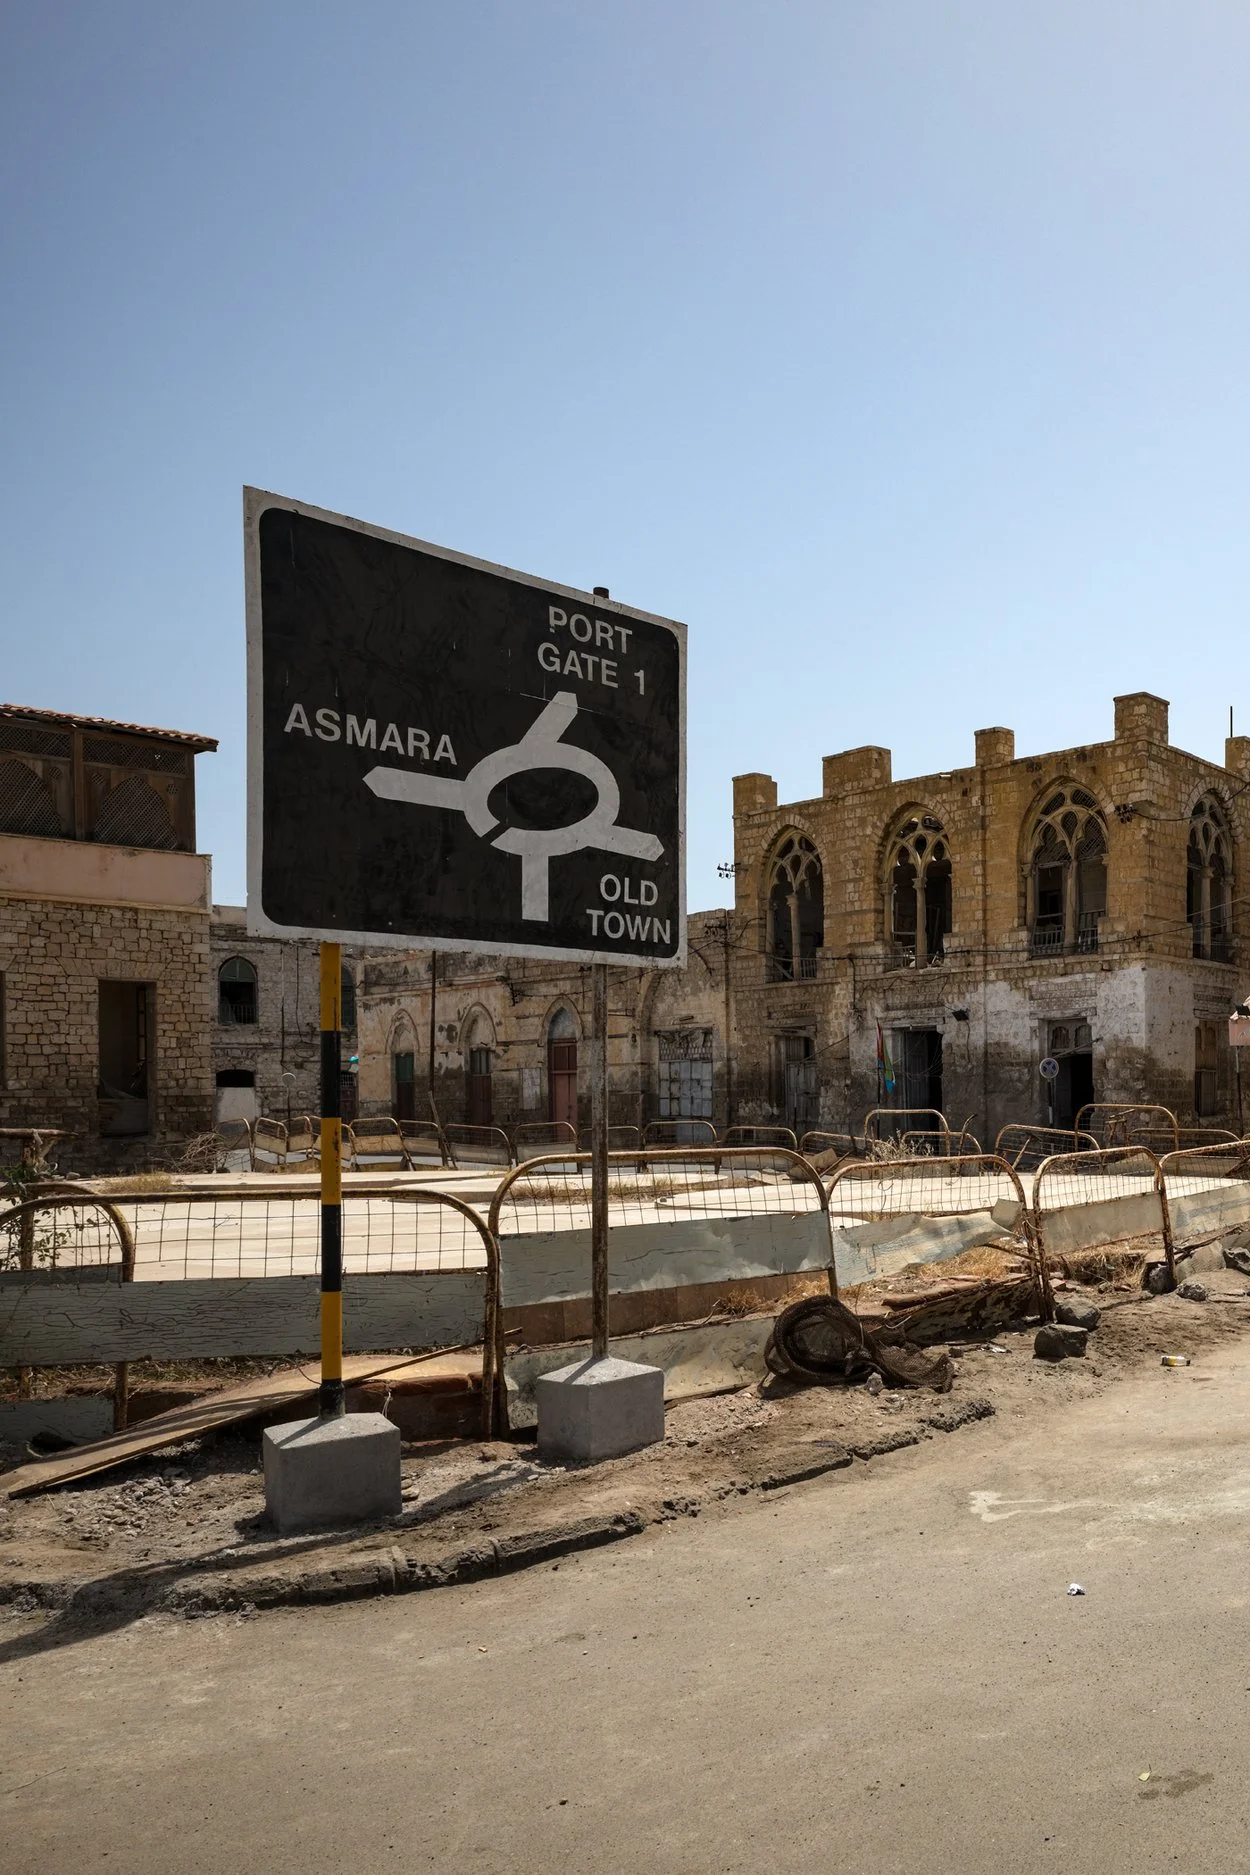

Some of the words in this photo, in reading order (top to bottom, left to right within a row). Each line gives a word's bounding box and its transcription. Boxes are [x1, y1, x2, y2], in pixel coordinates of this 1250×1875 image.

[549, 605, 633, 654] PORT
[537, 641, 619, 689] GATE
[634, 669, 646, 696] 1
[284, 703, 458, 766] ASMARA
[600, 873, 659, 907] OLD
[586, 909, 672, 945] TOWN
